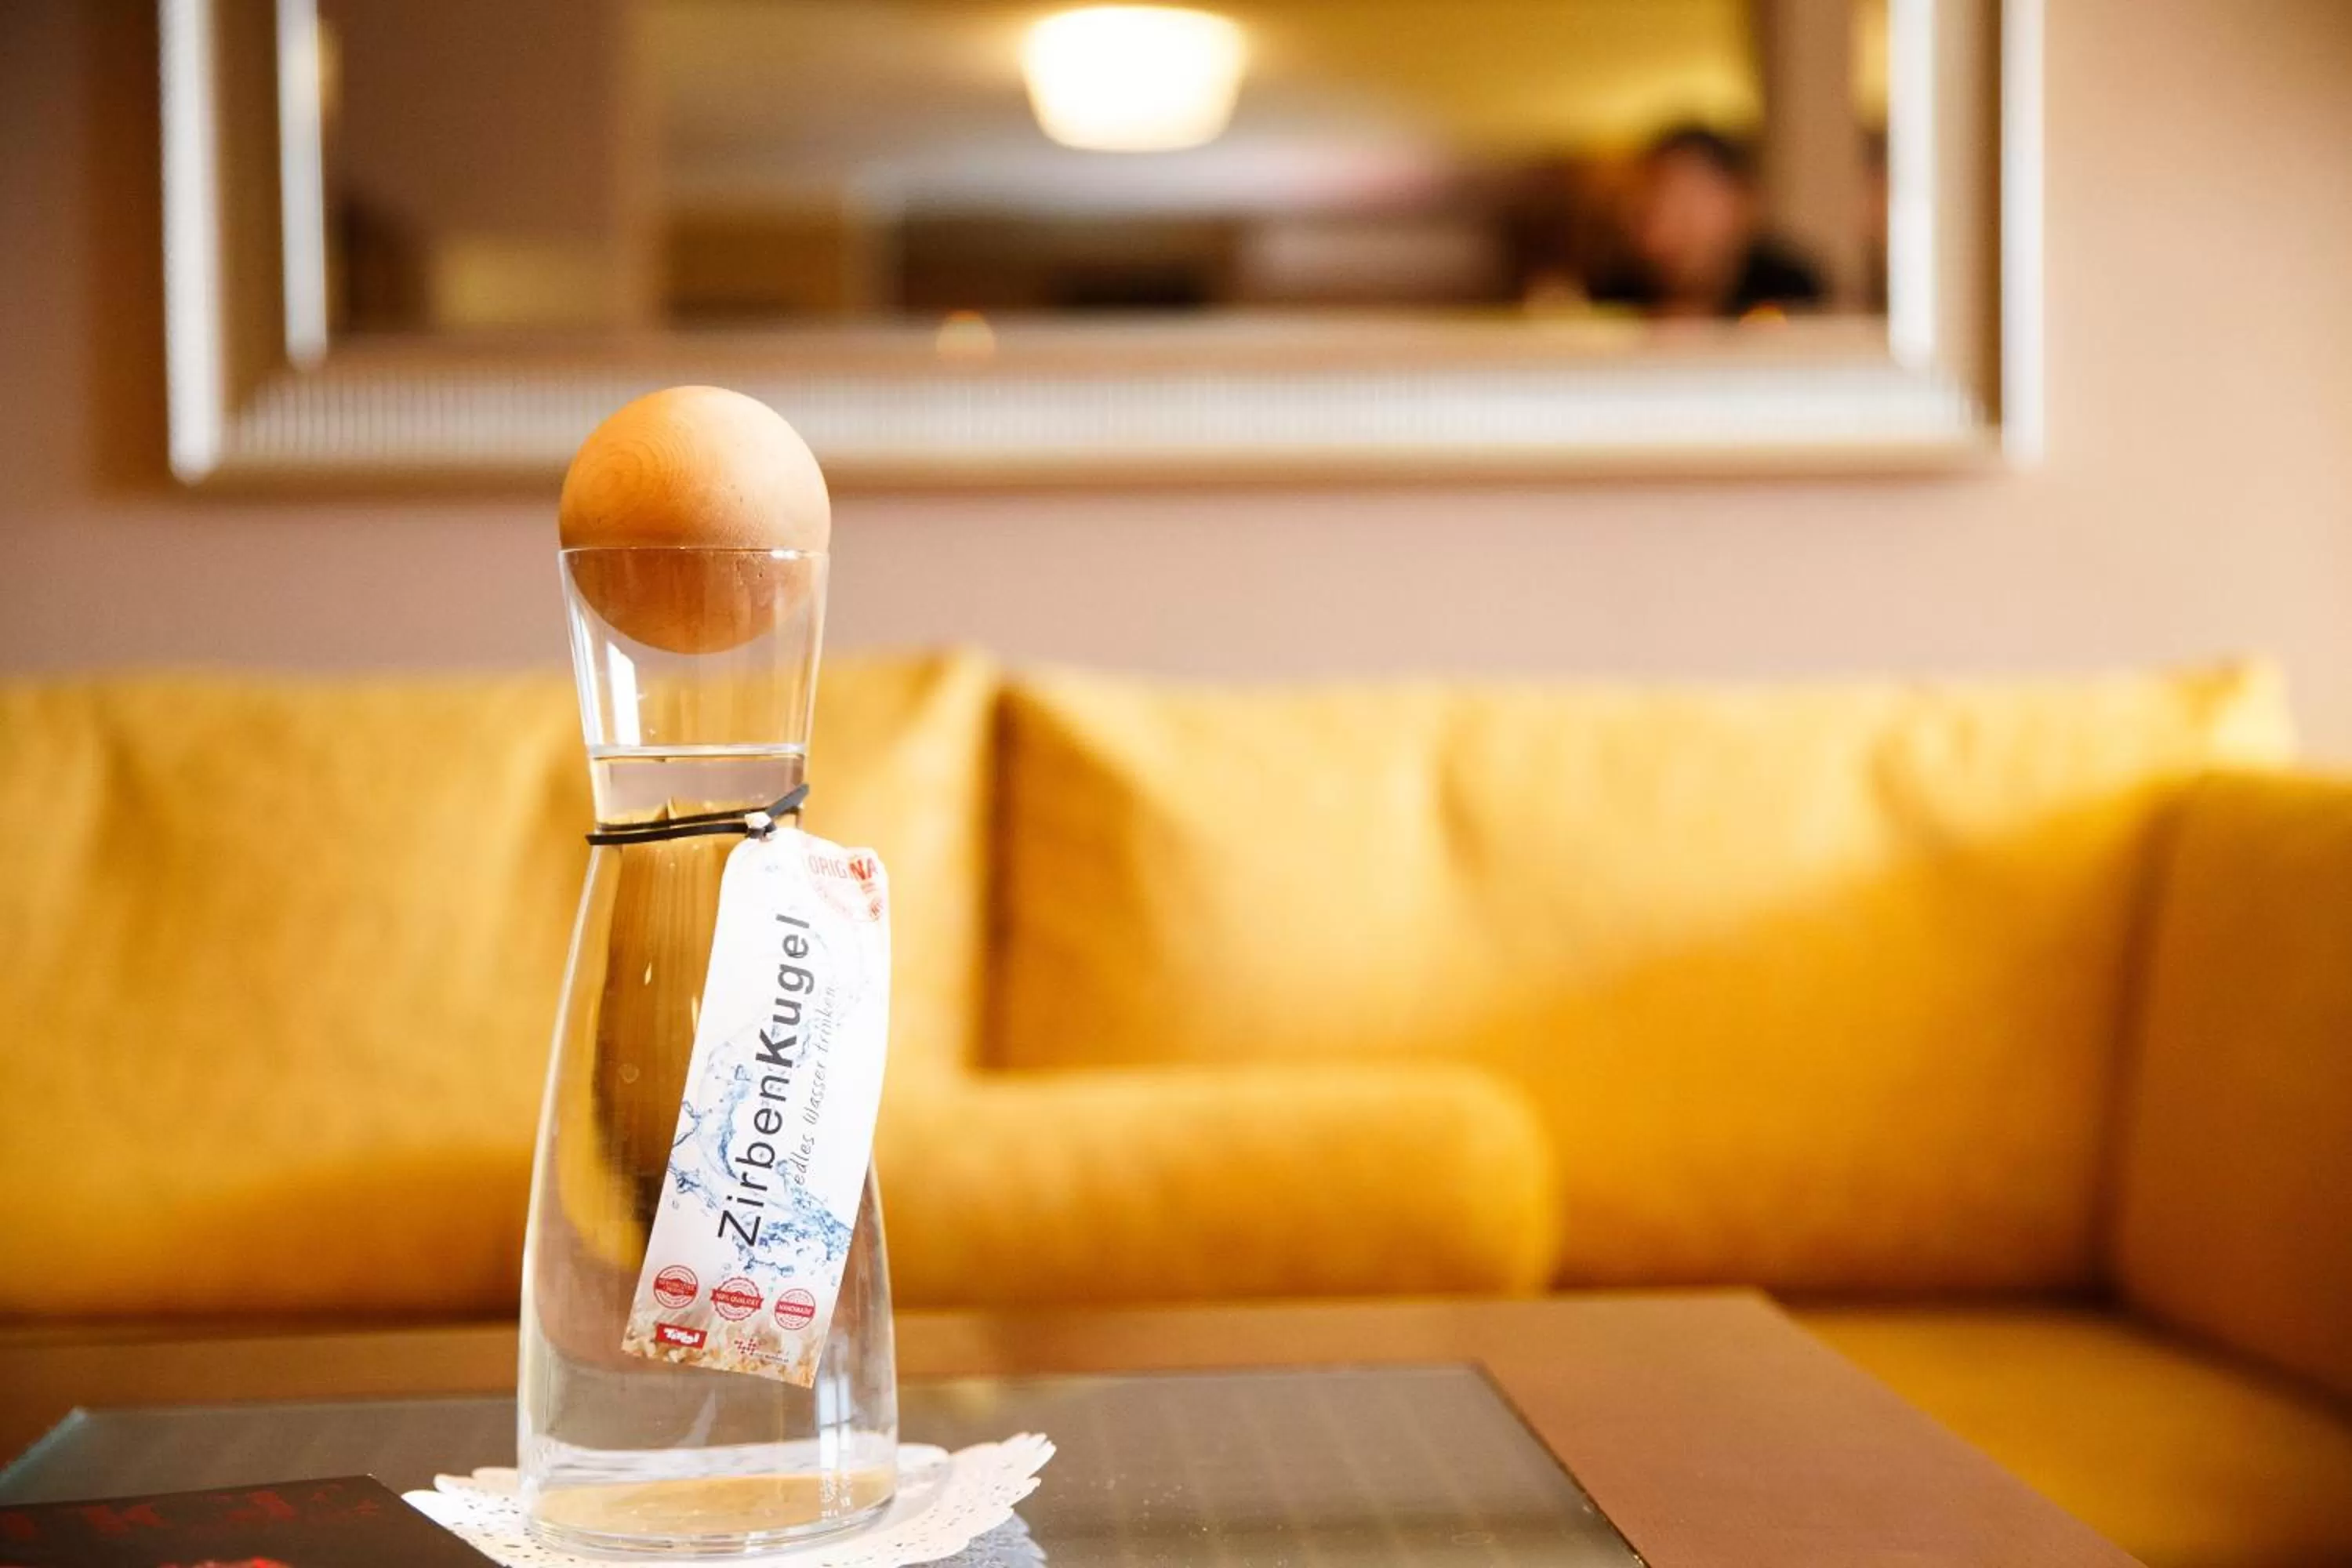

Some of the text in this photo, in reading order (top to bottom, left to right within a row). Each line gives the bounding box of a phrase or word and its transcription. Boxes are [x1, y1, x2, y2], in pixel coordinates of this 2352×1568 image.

[717, 914, 815, 1247] ZirbenKugel
[786, 1134, 815, 1186] edles
[804, 1062, 827, 1125] Wasser
